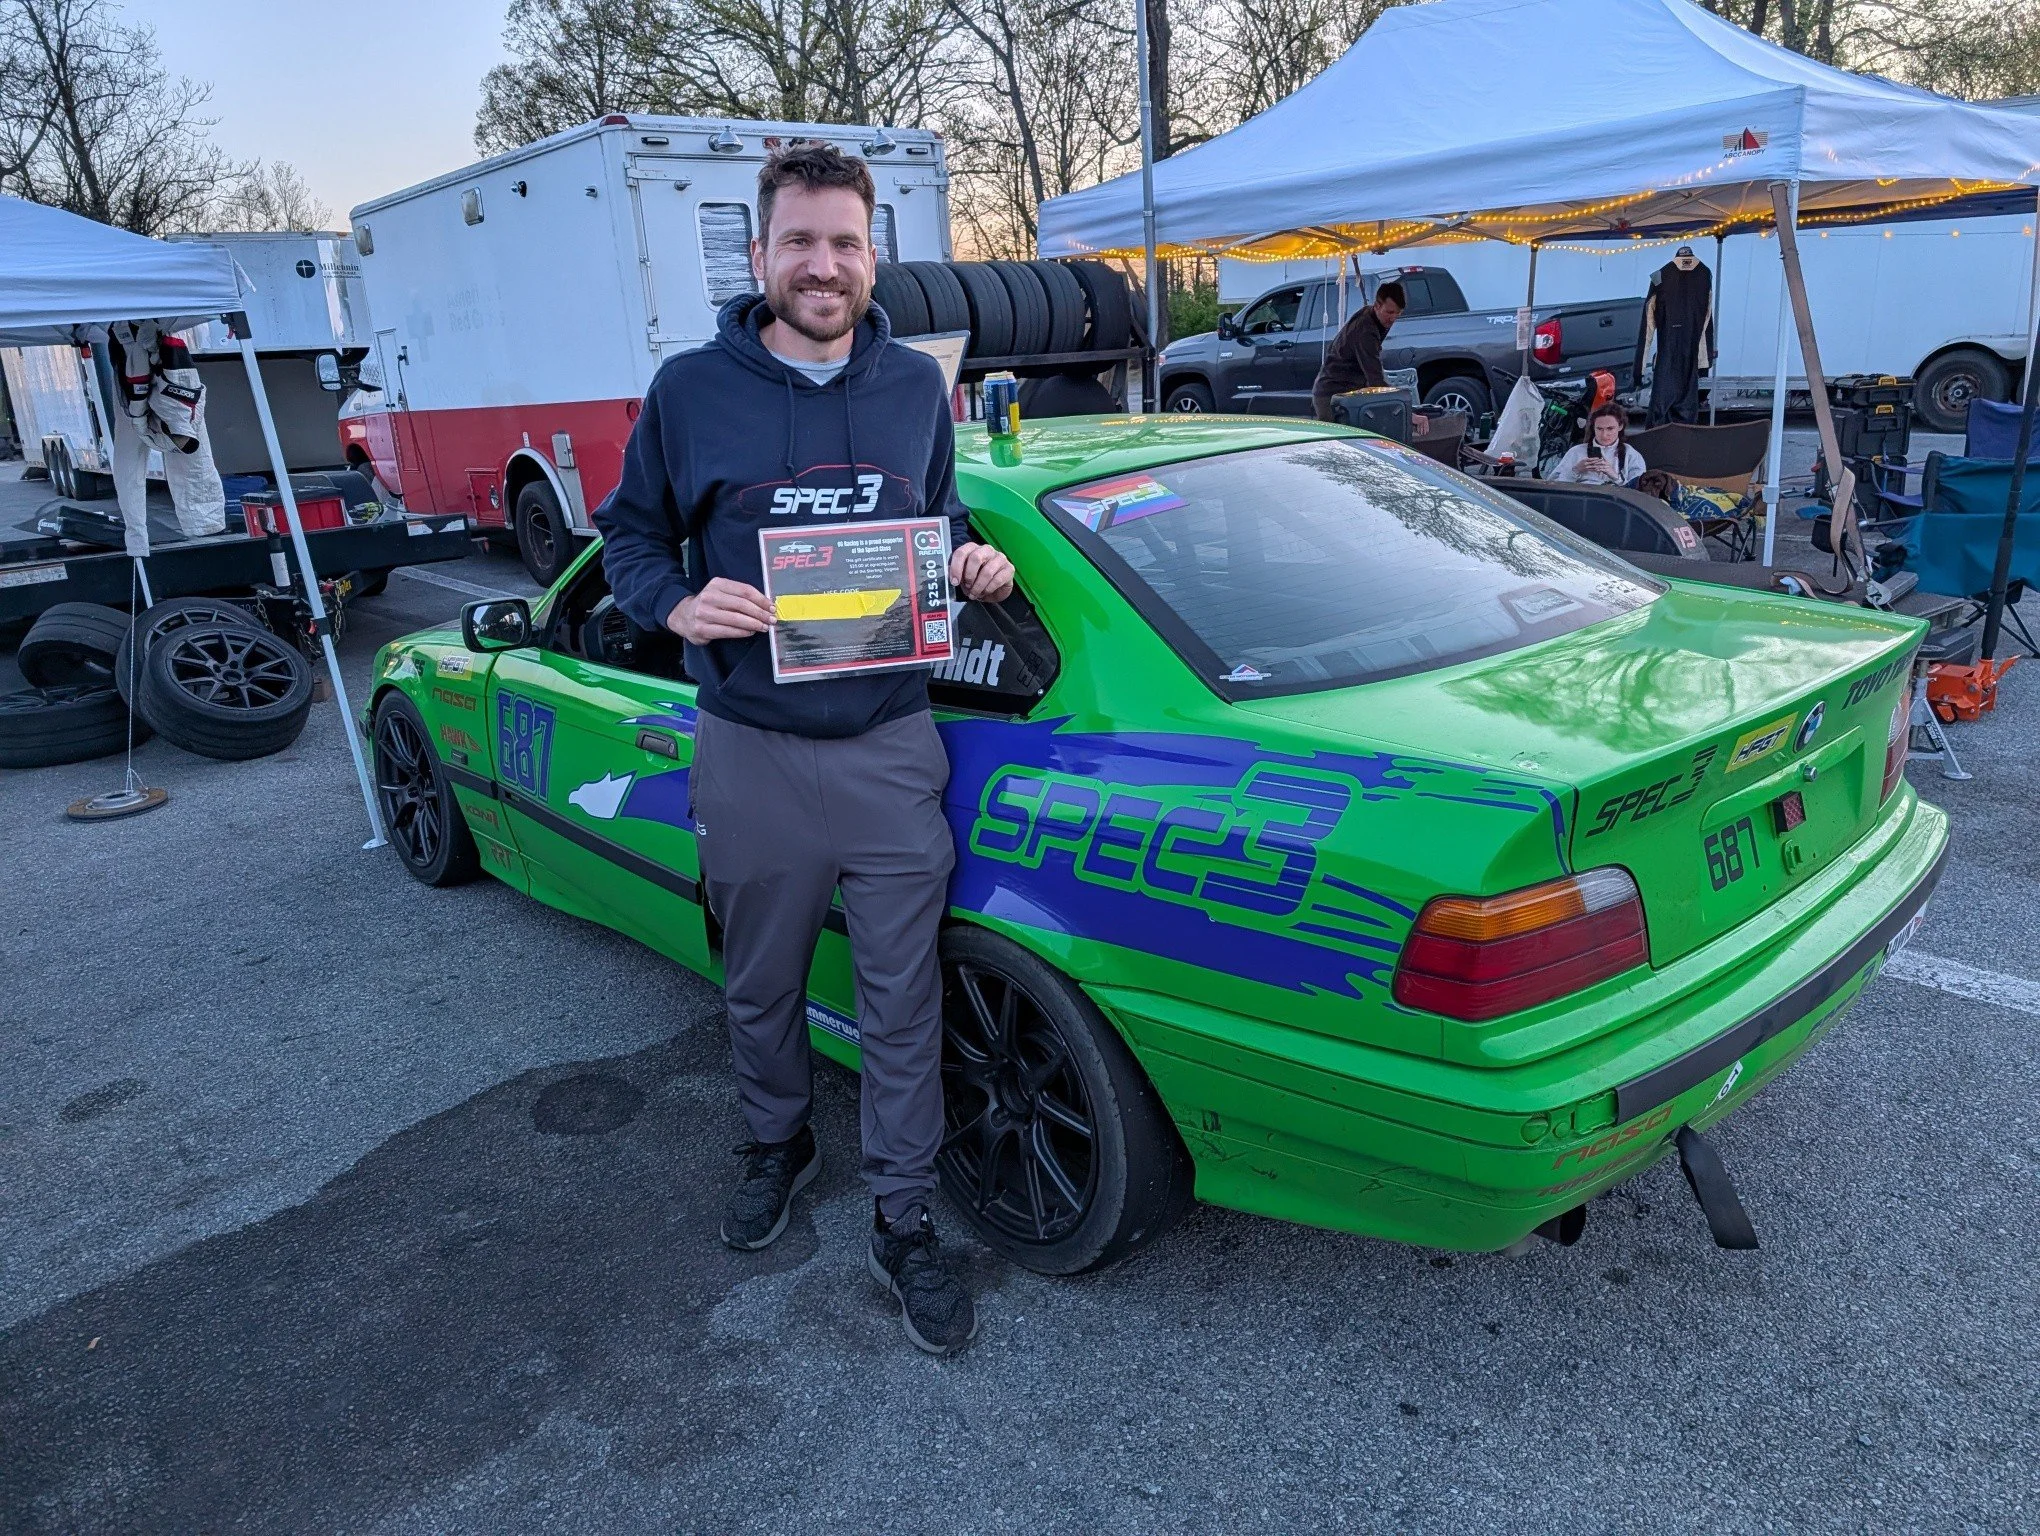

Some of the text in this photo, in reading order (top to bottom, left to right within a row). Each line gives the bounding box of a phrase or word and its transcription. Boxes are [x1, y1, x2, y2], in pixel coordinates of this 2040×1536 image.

[1723, 148, 1766, 159] ABCCANOPY
[769, 473, 884, 515] SPEC3
[1086, 481, 1165, 516] SPEC3
[772, 546, 834, 570] SPEC3
[1673, 526, 1697, 549] 19
[926, 560, 941, 607] $25.00
[497, 688, 557, 804] 687
[1585, 744, 1719, 838] SPEC3
[972, 763, 1358, 923] SPEC3
[1703, 816, 1761, 892] 687
